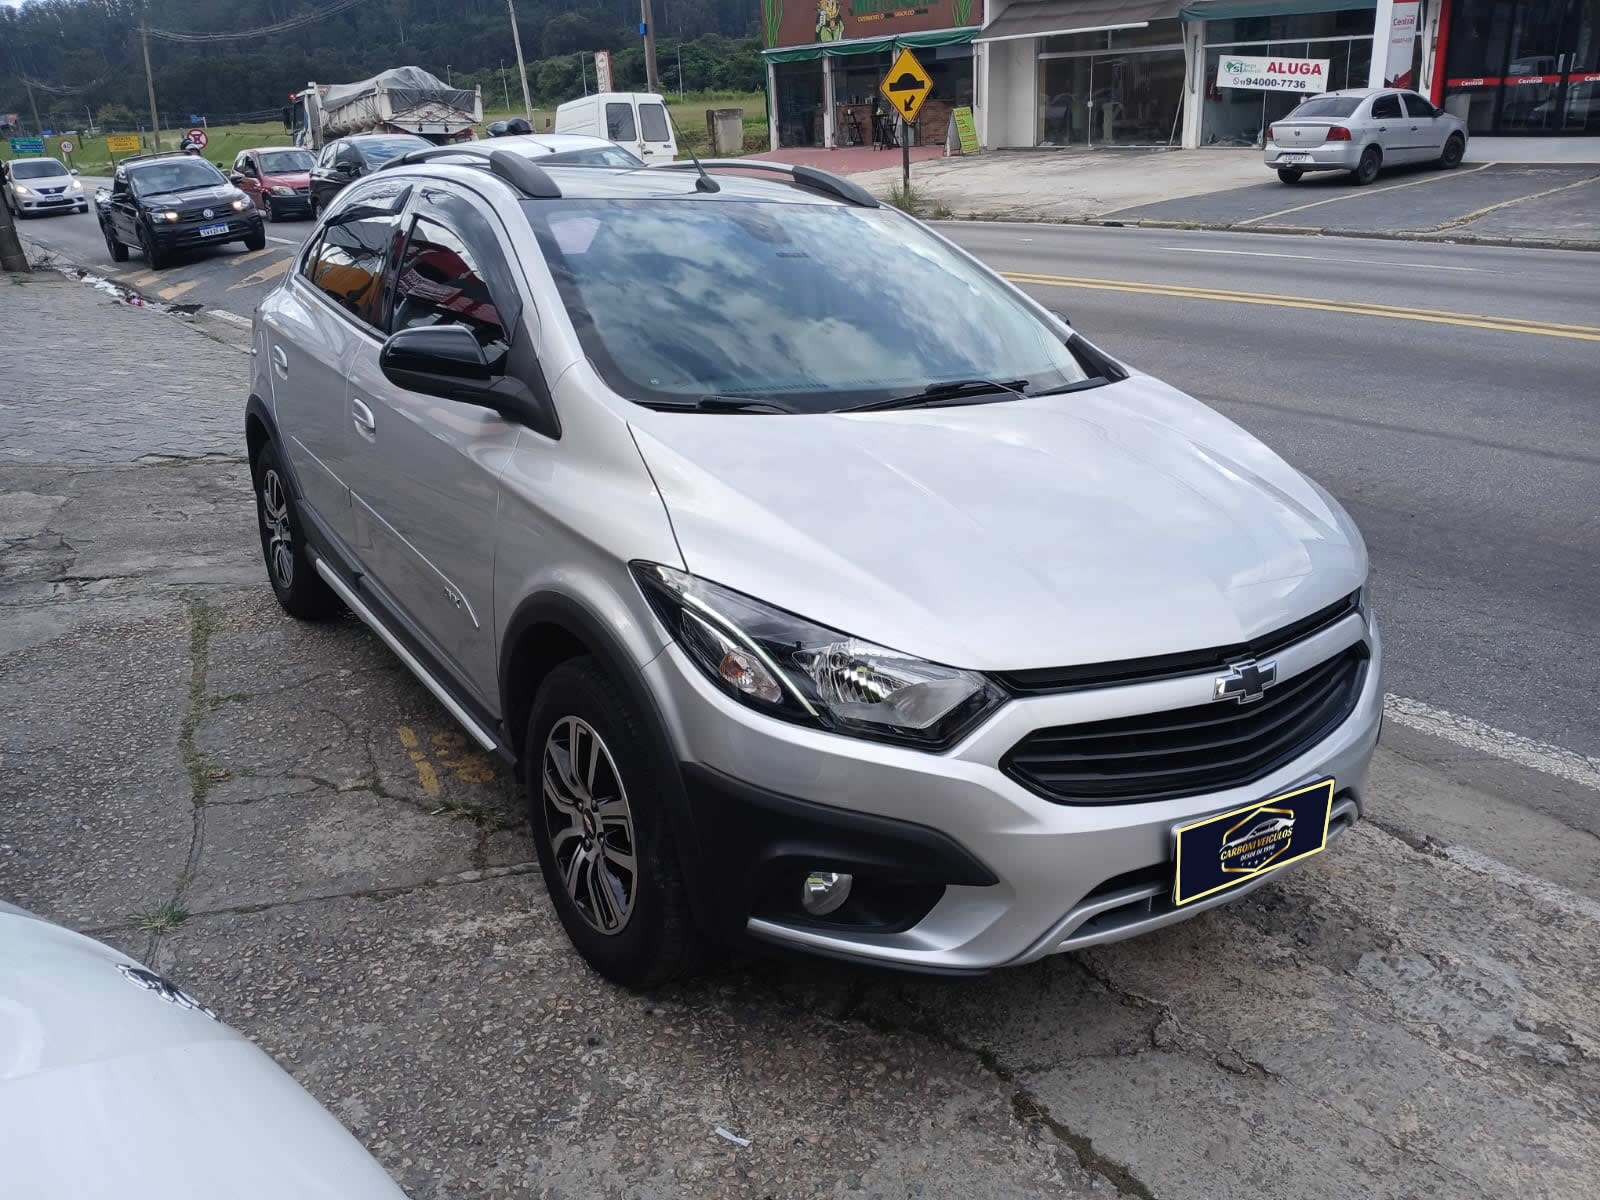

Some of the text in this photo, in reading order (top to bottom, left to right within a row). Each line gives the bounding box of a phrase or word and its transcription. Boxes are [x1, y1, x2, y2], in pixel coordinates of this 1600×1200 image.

[1393, 17, 1415, 26] Central
[1266, 62, 1322, 76] ALUGA
[1245, 77, 1306, 89] 94000-7736
[1461, 78, 1484, 87] Central
[1518, 76, 1543, 84] Central
